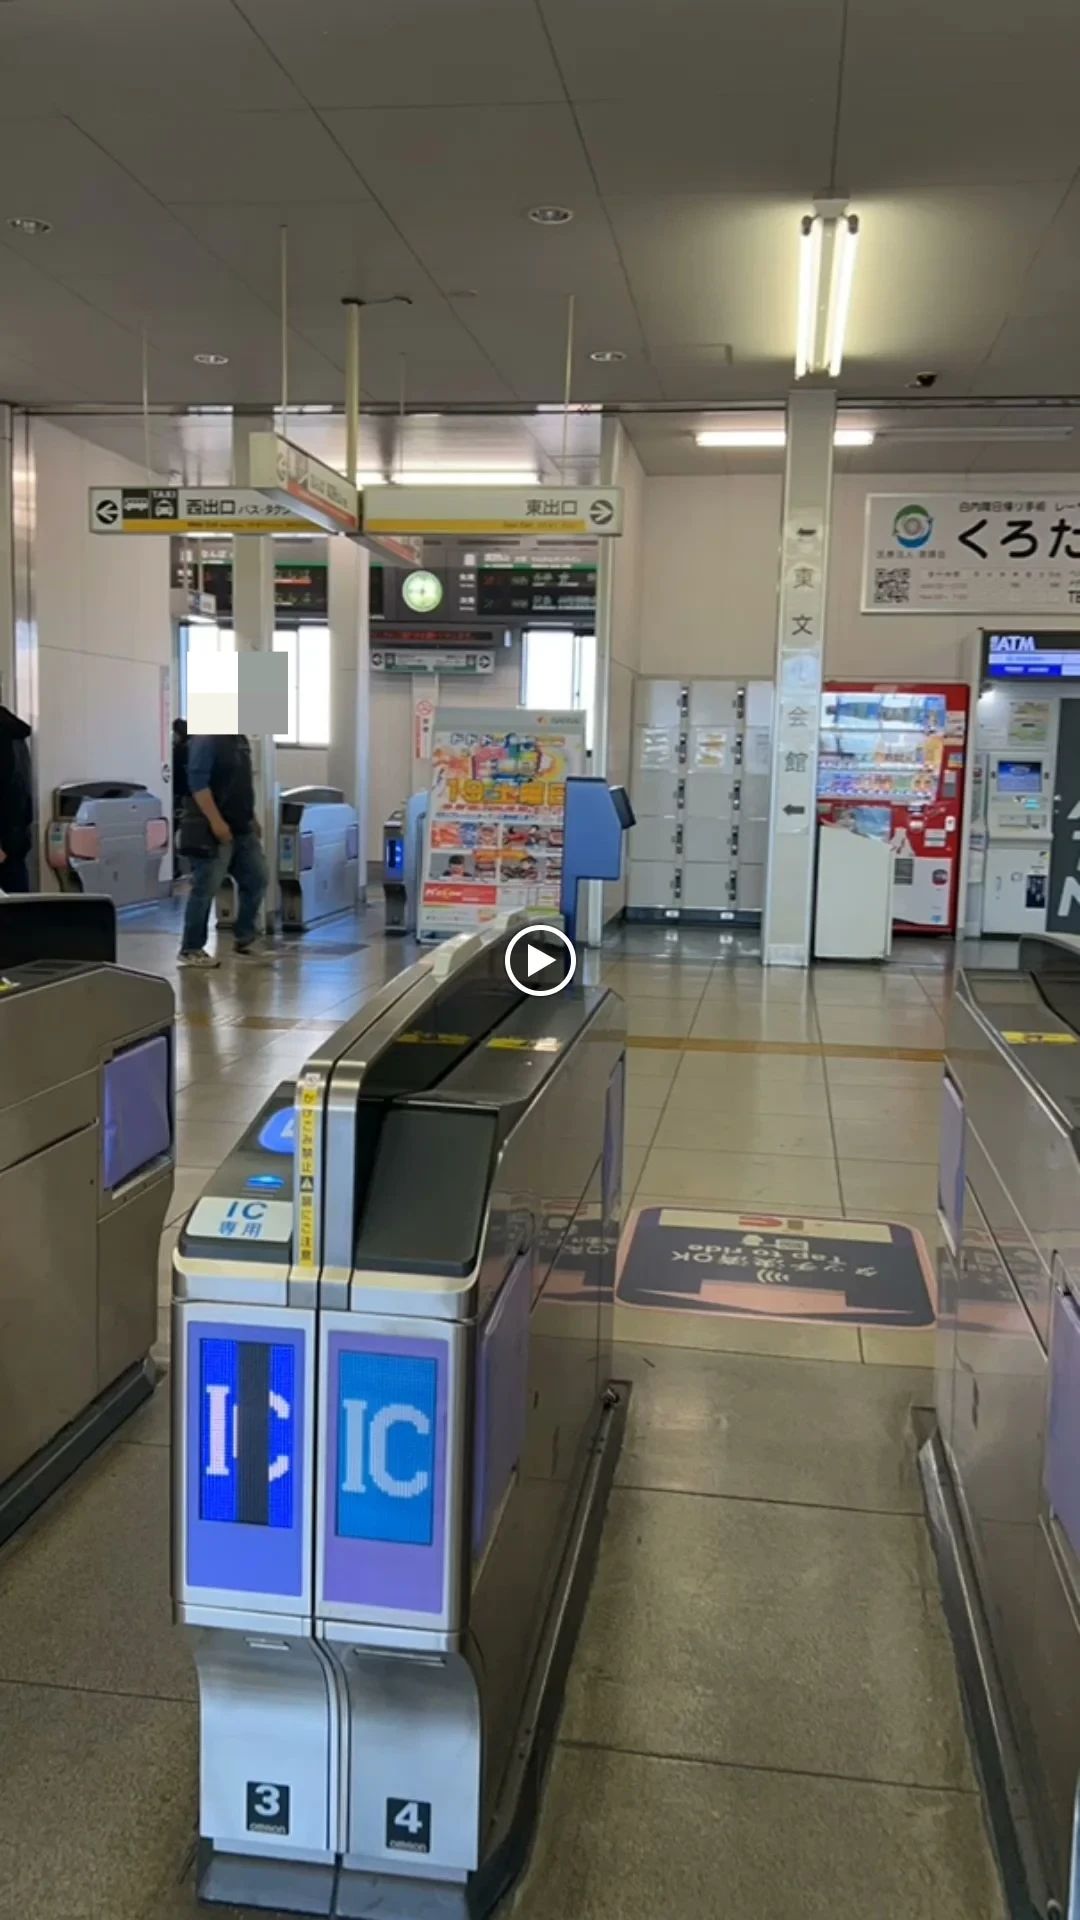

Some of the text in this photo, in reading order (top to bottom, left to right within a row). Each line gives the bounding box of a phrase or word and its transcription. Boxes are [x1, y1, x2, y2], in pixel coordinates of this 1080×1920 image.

[185, 499, 236, 515] 西出口
[525, 499, 578, 516] 東出口
[226, 1201, 268, 1219] IC
[218, 1221, 263, 1238] 専用
[687, 1244, 847, 1266] Tap to ride
[341, 1398, 430, 1498] IC
[254, 1783, 281, 1817] 3
[394, 1802, 423, 1834] 4
